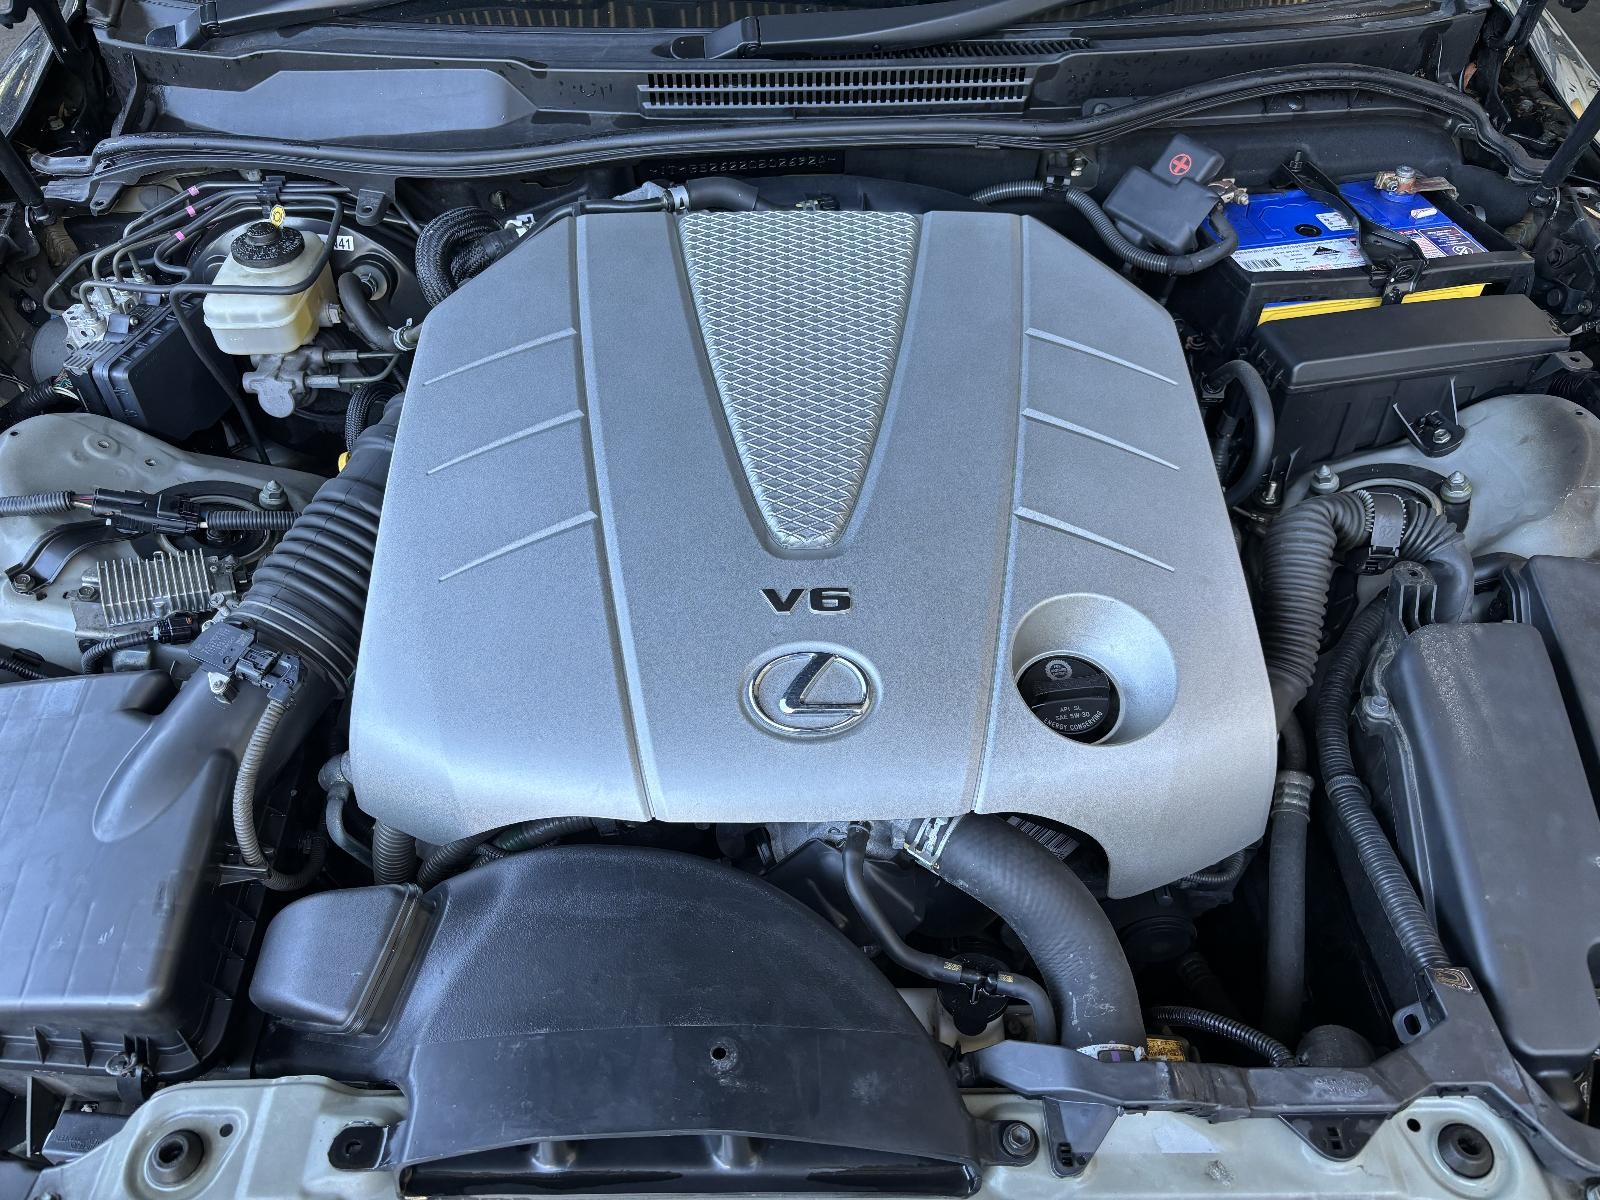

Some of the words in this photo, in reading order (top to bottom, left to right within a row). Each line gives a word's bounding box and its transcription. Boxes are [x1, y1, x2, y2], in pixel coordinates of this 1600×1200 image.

[759, 587, 851, 615] V6
[1043, 717, 1068, 731] ENERGY
[1069, 710, 1103, 731] CONSERVING
